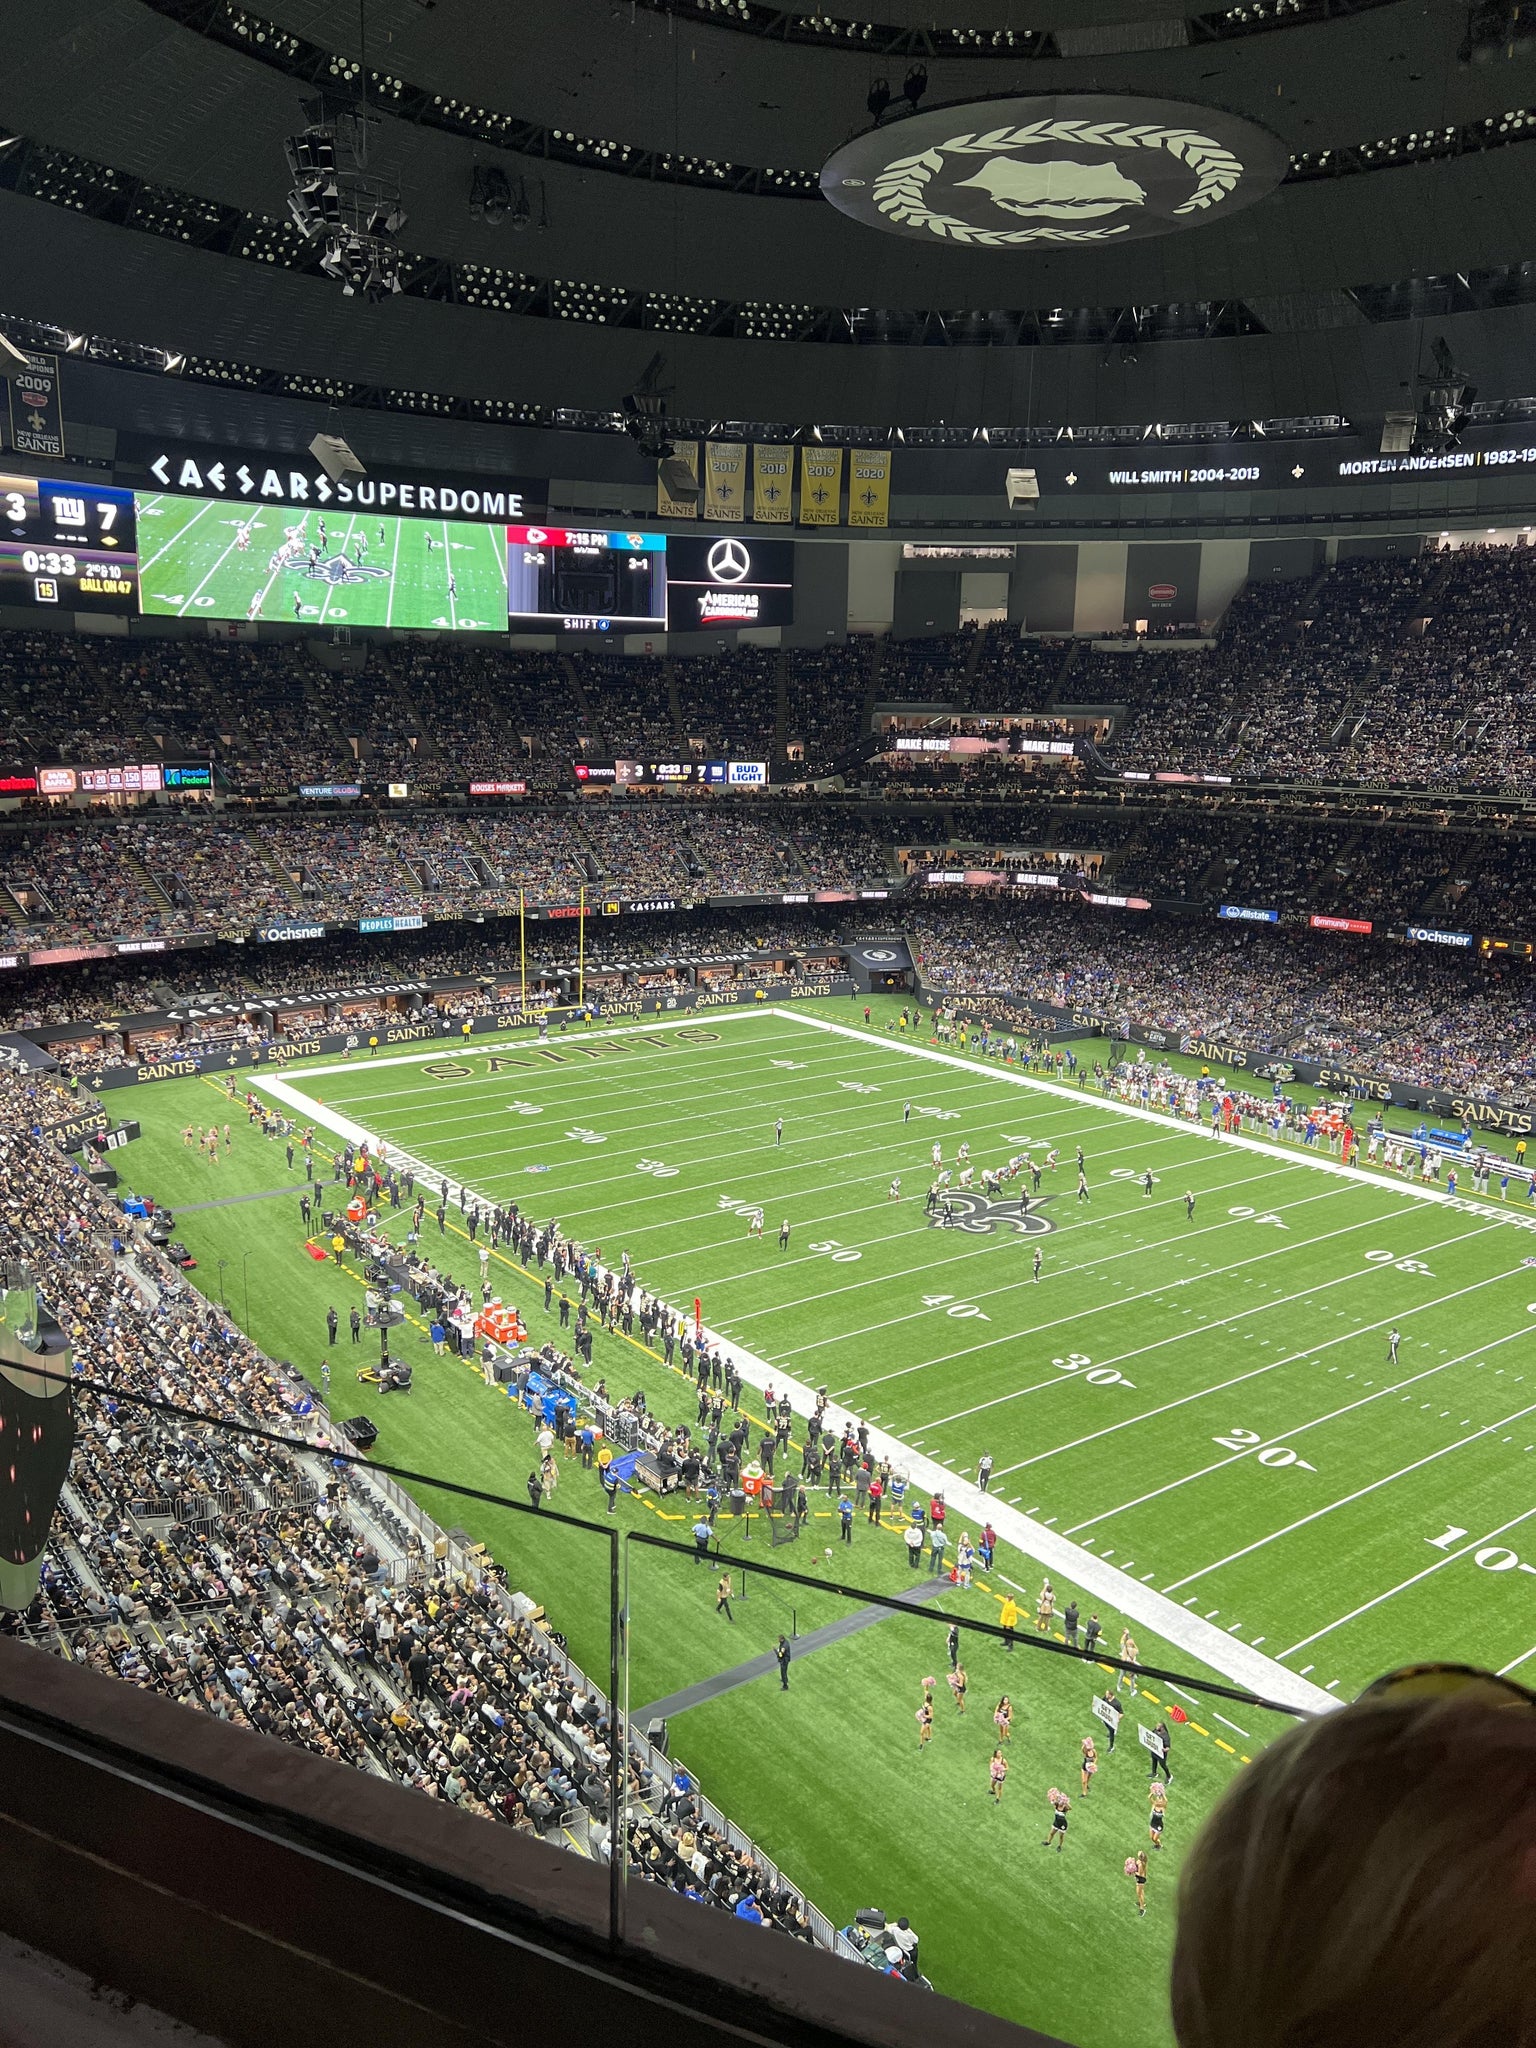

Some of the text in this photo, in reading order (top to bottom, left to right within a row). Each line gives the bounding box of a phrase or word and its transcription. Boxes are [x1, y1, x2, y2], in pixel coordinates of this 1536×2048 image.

[16, 375, 51, 392] 2009
[17, 437, 60, 453] SAINTS
[712, 461, 739, 472] 2017
[760, 463, 787, 474] 2018
[1339, 459, 1397, 476] MORTEN
[1399, 453, 1474, 471] ANDERSEN
[808, 466, 835, 477] 2019
[856, 468, 884, 479] 2020
[1109, 467, 1260, 484] WILL SMITH 2004-2013
[151, 455, 524, 517] CAESARS SUPERDOME
[5, 493, 26, 521] 3
[660, 505, 694, 516] SAINTS
[706, 508, 741, 519] SAINTS
[97, 503, 117, 530] 7
[755, 511, 789, 521] SAINTS
[802, 513, 836, 523] SAINTS
[851, 516, 885, 525] SAINTS
[565, 532, 608, 546] 7:15 PM
[23, 550, 76, 576] 0:33
[523, 552, 545, 565] 2-2
[628, 557, 648, 570] 3-1
[110, 565, 121, 579] 10
[39, 583, 53, 597] 15
[80, 578, 131, 594] BALL ON 47
[698, 590, 759, 608] AMERICAS
[896, 738, 950, 751] MAKE NOISE
[1023, 740, 1074, 754] MAKE NOISE
[588, 768, 616, 776] TOYOTA
[635, 764, 644, 777] 3
[697, 765, 707, 777] 7
[736, 765, 758, 773] BUD
[125, 772, 139, 782] 150
[181, 776, 210, 784] Federal
[732, 773, 763, 782] LIGHT
[1294, 778, 1323, 786] SAINTS
[259, 785, 289, 794] SAINTS
[300, 786, 360, 796] VENTURE GLOBAL
[413, 783, 441, 791] SAINTS
[471, 782, 525, 792] ROUSES MARKETS
[532, 782, 558, 790] SAINTS
[1359, 781, 1390, 790] SAINTS
[1427, 784, 1459, 794] SAINTS
[1280, 793, 1307, 801] SAINTS
[1499, 788, 1533, 798] SAINTS
[1339, 797, 1368, 805] SAINTS
[1402, 800, 1431, 809] SAINTS
[1467, 805, 1498, 814] SAINTS
[1017, 873, 1059, 885] MAKE NOISE
[547, 905, 590, 918] verizon
[606, 903, 618, 913] 14
[629, 900, 676, 912] CAESARS
[434, 912, 463, 921] SAINTS
[1281, 913, 1308, 923] SAINTS
[1314, 916, 1350, 930] Community
[361, 917, 421, 931] PEOPLES HEALTH
[217, 929, 250, 940] SAINTS
[267, 926, 323, 942] Ochsner
[1417, 929, 1470, 946] Ochsner
[1483, 940, 1490, 949] 2
[540, 953, 753, 977] CAESARS SUPERDOME
[791, 985, 831, 998] SAINTS
[167, 981, 432, 1020] CAESARS SUPERDOME
[698, 992, 738, 1006] SAINTS
[600, 1000, 642, 1015] SAINTS
[387, 1024, 434, 1042] SAINT
[267, 1040, 321, 1060] SAINTS
[421, 1028, 723, 1080] SAINTS
[1188, 1039, 1247, 1067] SAINTS
[137, 1059, 196, 1082] SAINTS
[1320, 1069, 1390, 1100] SAINTS
[1452, 1099, 1532, 1132] SAINTS
[635, 1160, 680, 1178] 30
[808, 1239, 863, 1263] 50
[921, 1294, 981, 1319] 40
[1051, 1353, 1123, 1386] 30
[1212, 1427, 1298, 1468] 20
[745, 1480, 755, 1490] G
[1423, 1523, 1519, 1571] 10
